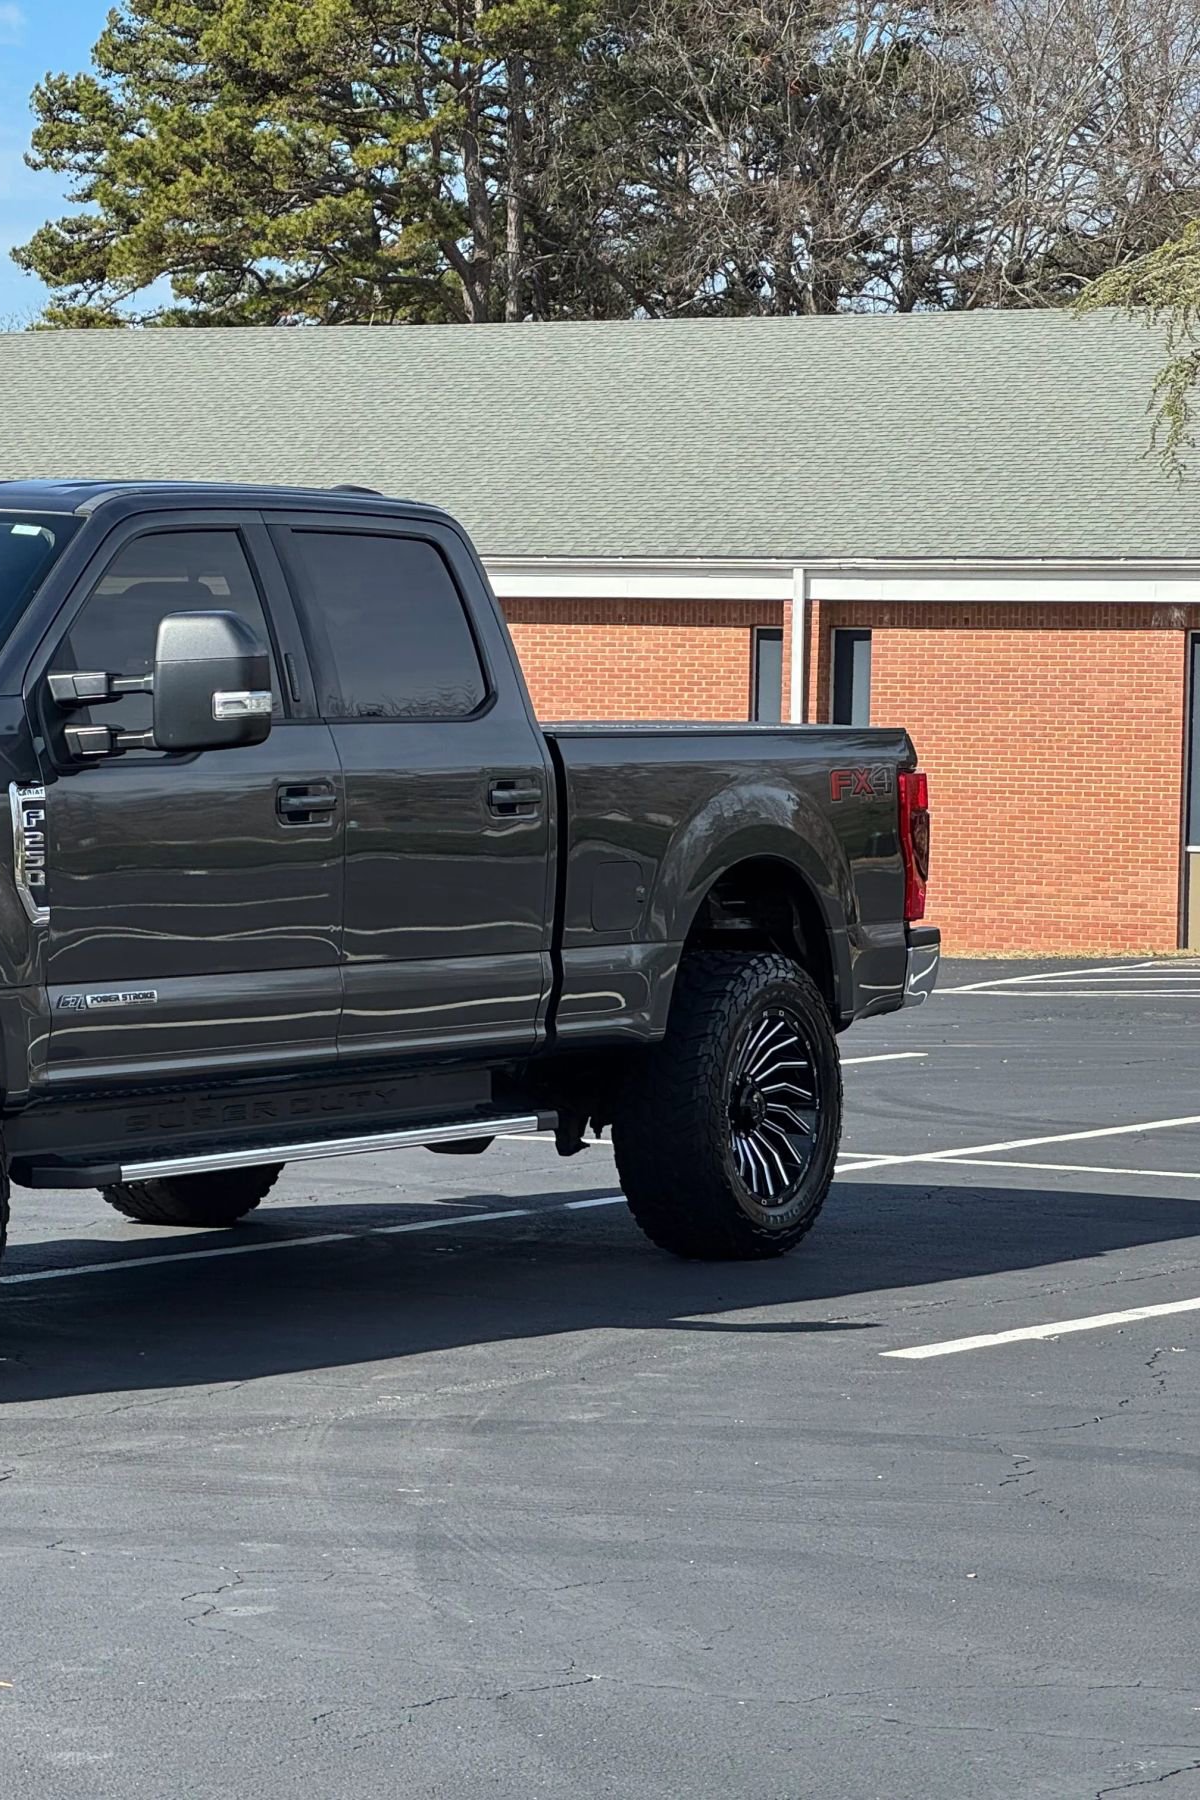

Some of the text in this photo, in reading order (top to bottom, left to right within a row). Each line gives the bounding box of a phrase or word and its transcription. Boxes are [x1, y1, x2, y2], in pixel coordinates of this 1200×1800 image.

[829, 766, 893, 803] FX4
[90, 994, 120, 1004] POWER
[121, 991, 156, 1001] STROKE
[126, 1088, 397, 1133] SUPER DUTY
